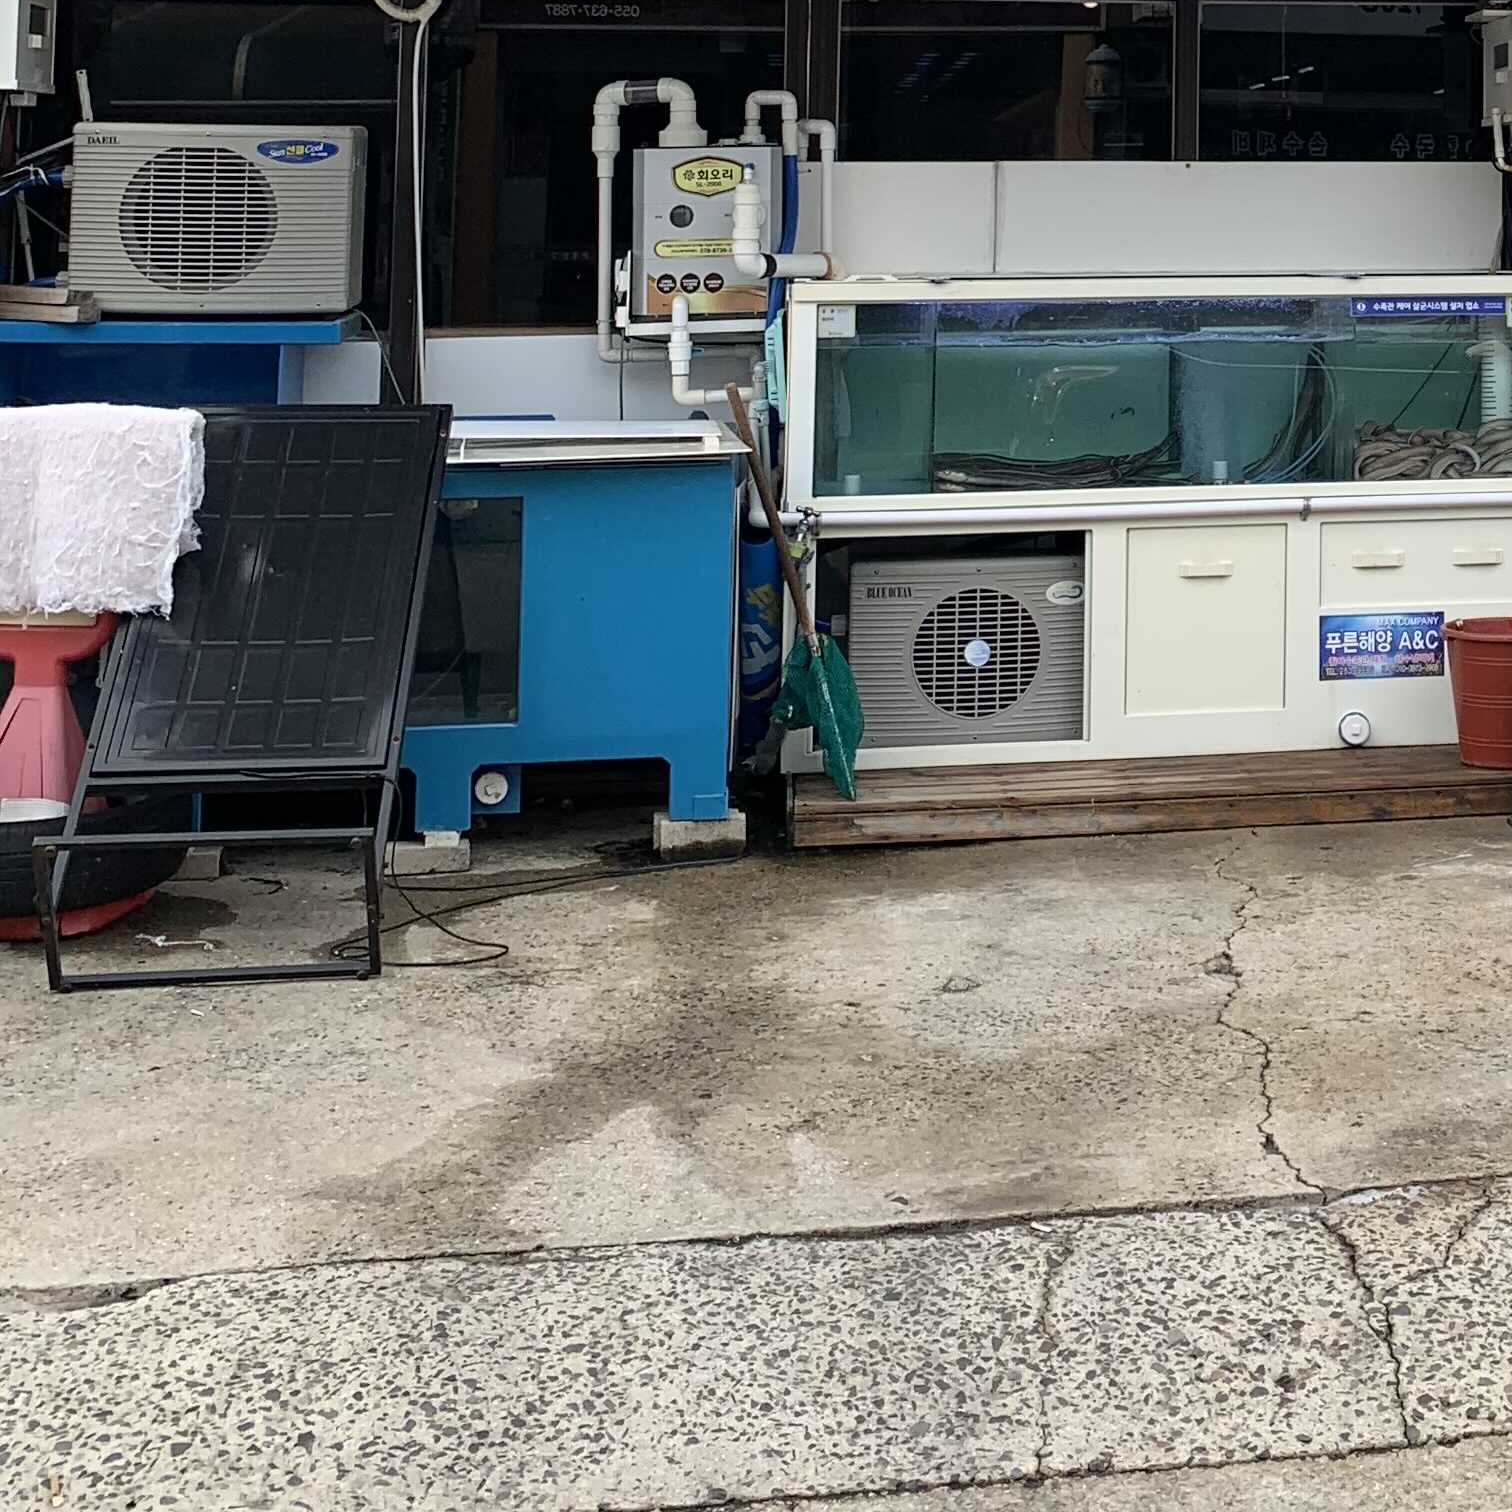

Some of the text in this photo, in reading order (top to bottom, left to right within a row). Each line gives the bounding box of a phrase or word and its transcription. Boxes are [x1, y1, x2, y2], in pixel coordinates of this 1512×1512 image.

[696, 168, 734, 181] 회오리
[1325, 629, 1439, 654] 푸른해양 A&C
